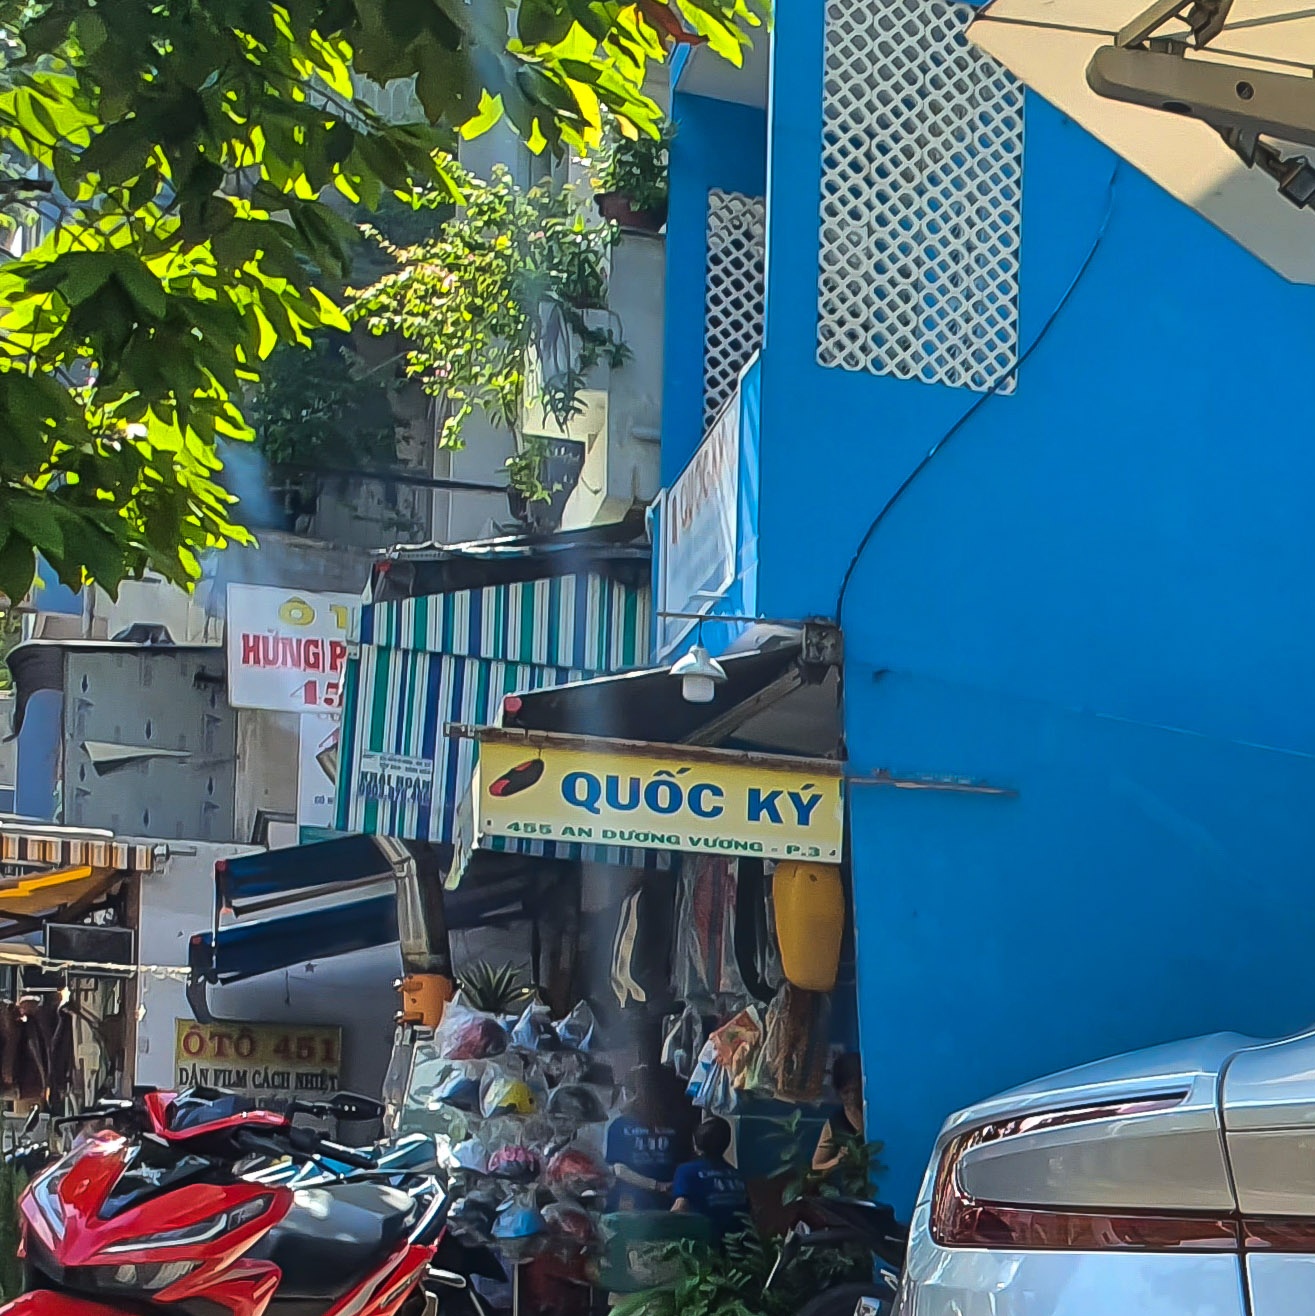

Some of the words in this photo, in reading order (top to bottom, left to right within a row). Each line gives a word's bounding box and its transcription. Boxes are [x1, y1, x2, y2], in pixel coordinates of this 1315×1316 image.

[561, 767, 724, 818] QUỐC
[747, 783, 824, 826] KÝ
[561, 826, 592, 838] AN
[602, 829, 681, 845] DƯƠNG
[689, 836, 763, 852] VƯƠNG
[272, 1034, 337, 1062] 451
[213, 1068, 248, 1088] FILM
